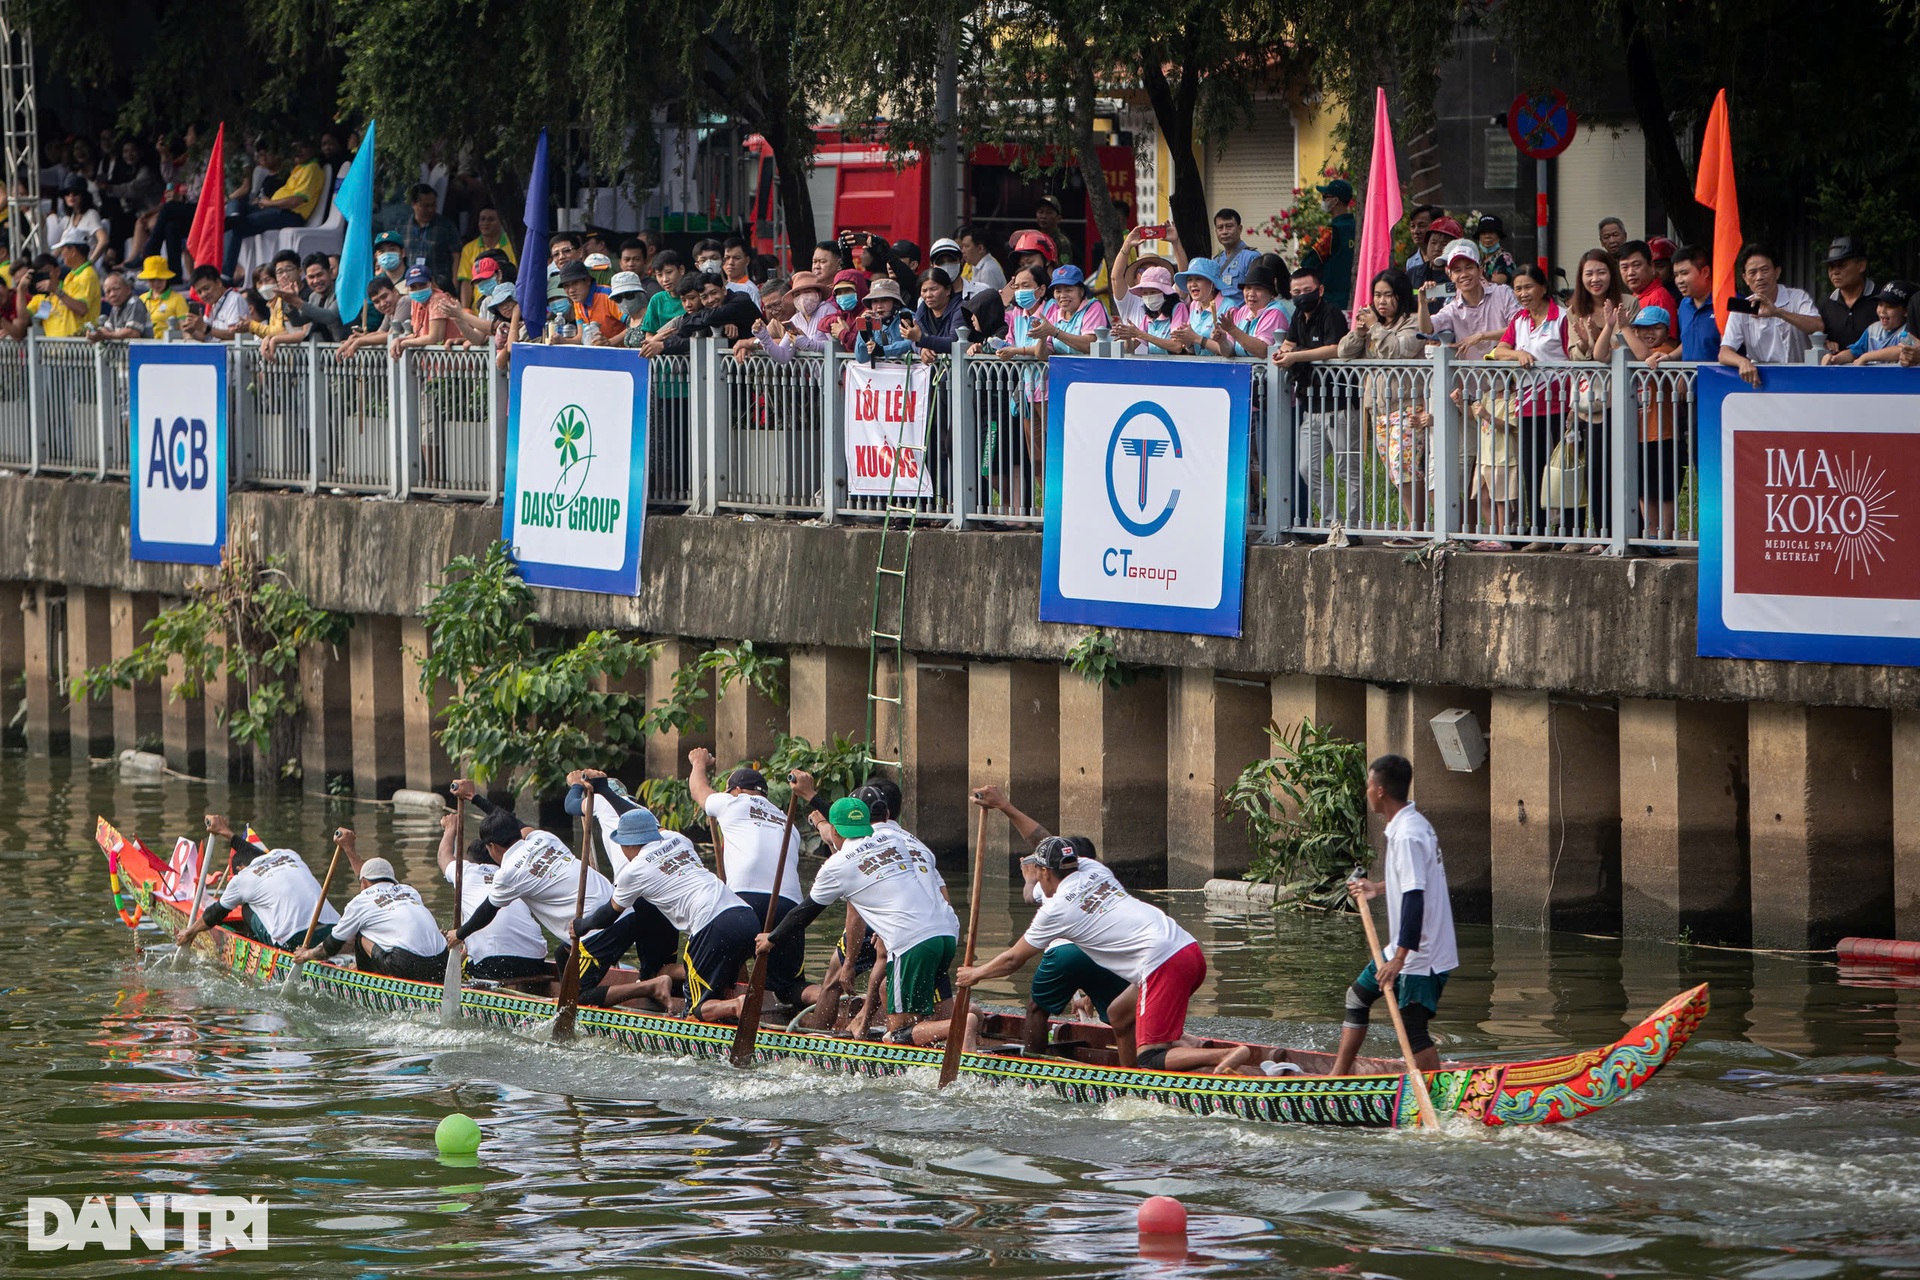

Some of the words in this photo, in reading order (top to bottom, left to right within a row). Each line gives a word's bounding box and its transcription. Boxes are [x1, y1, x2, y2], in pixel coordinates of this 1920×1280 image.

[855, 379, 880, 422] LỐI
[885, 384, 917, 423] LÊN
[147, 416, 209, 491] ACB
[855, 435, 918, 479] XUỐNG
[1765, 448, 1838, 489] IMA
[521, 491, 565, 529] DAISY
[568, 495, 621, 534] GROUP
[1765, 493, 1867, 535] KOKO
[1765, 540, 1810, 550] MEDICAL
[1814, 541, 1833, 551] SPA
[1765, 552, 1771, 561] &
[1776, 552, 1820, 562] RETREAT
